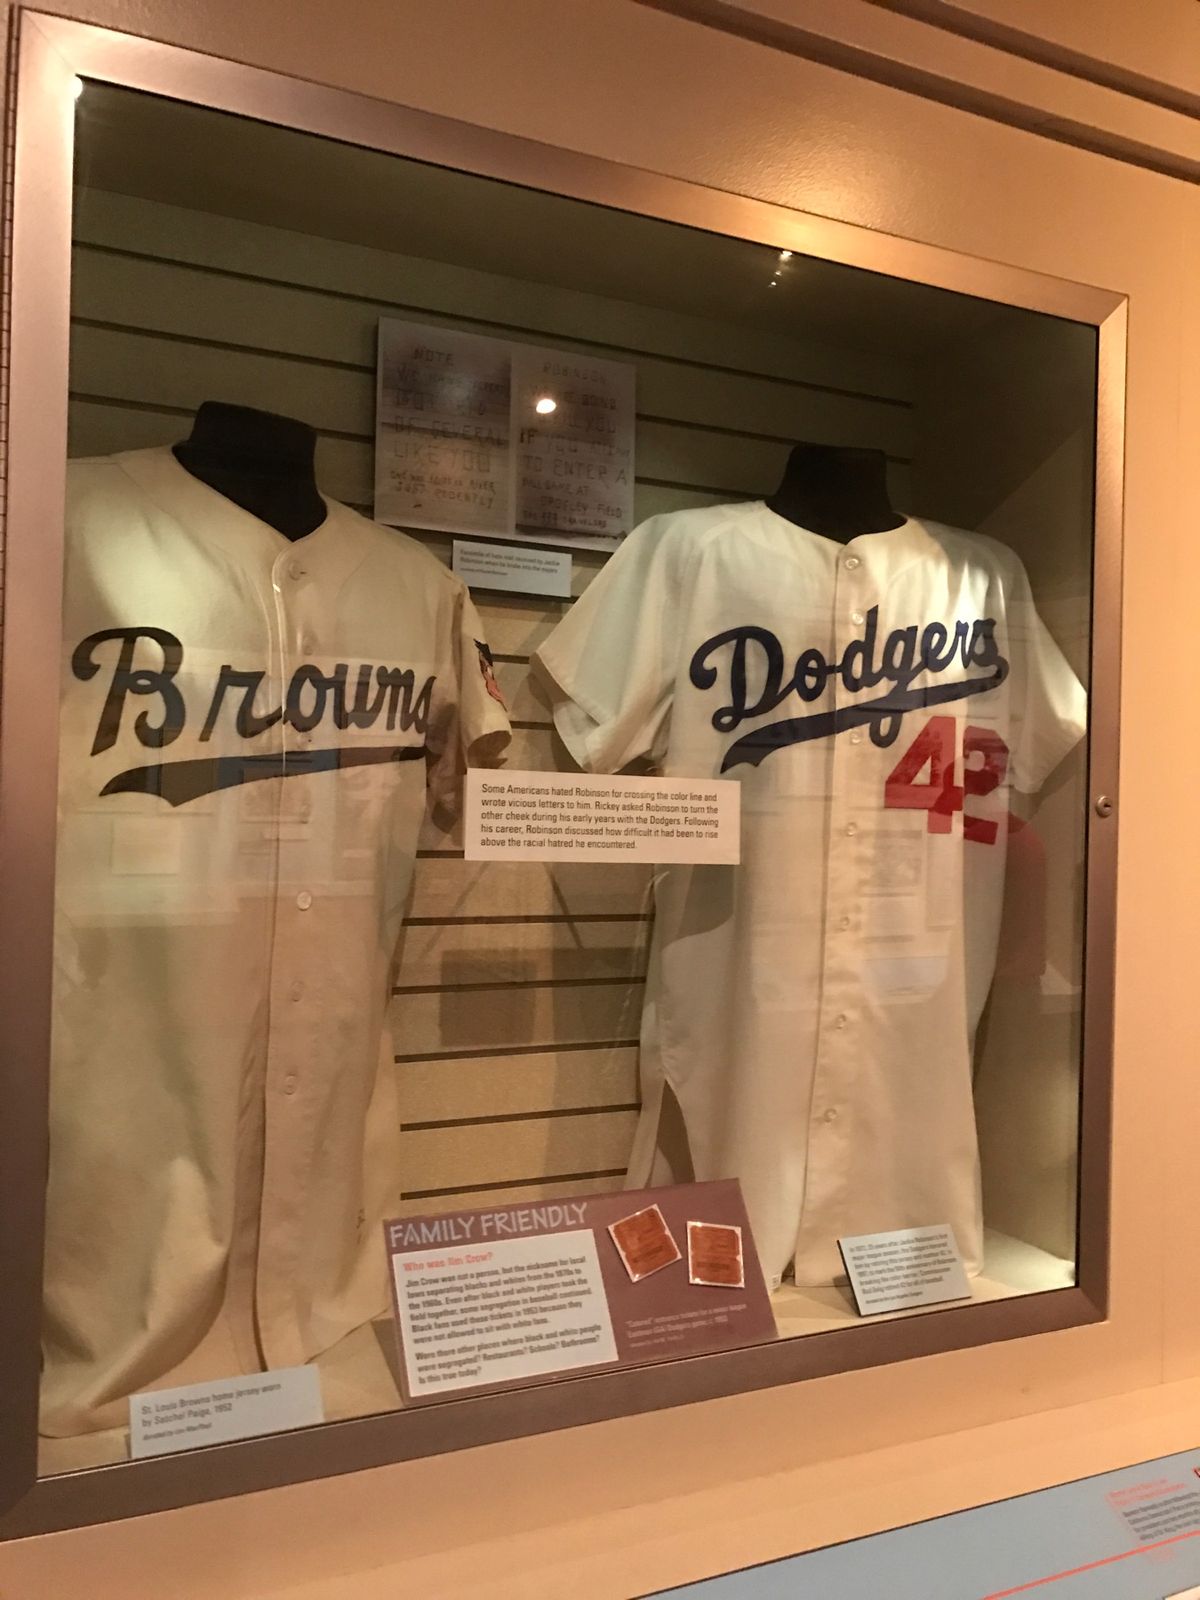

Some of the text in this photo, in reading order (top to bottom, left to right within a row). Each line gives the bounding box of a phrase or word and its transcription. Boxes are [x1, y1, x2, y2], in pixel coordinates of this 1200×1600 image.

[690, 604, 1009, 749] Dodgers
[71, 627, 437, 756] Browns
[884, 715, 1010, 845] 42
[482, 783, 717, 802] Some Americans hated Robinson for crossing the color line and
[481, 798, 506, 807] wrote
[508, 799, 536, 808] vicious
[538, 799, 565, 809] letters
[567, 801, 575, 809] to
[595, 801, 620, 812] Rickey
[622, 802, 643, 812] asked
[645, 803, 680, 813] Robinson
[681, 805, 689, 813] to
[690, 805, 705, 814] turn
[706, 805, 718, 814] the
[481, 811, 503, 820] other
[505, 811, 530, 820] cheek
[532, 812, 557, 823] during
[559, 813, 571, 822] his
[573, 814, 592, 824] early
[594, 816, 615, 825] years
[617, 814, 634, 823] with
[636, 815, 647, 824] the
[684, 816, 719, 828] Following
[481, 823, 493, 833] his
[526, 824, 562, 835] Robinson
[565, 826, 603, 836] discussed
[605, 827, 621, 836] how
[624, 827, 652, 837] difficult
[654, 828, 659, 837] it
[661, 829, 674, 838] had
[676, 829, 695, 838] been
[696, 830, 703, 838] to
[705, 831, 718, 839] rise
[481, 837, 506, 847] above
[508, 837, 521, 847] the
[523, 838, 546, 847] racial
[547, 838, 573, 848] hatred
[575, 839, 585, 848] he
[389, 1202, 588, 1248] FAMILY FRIENDLY
[403, 1262, 424, 1271] Who
[426, 1260, 445, 1269] was
[448, 1257, 463, 1266] Jim
